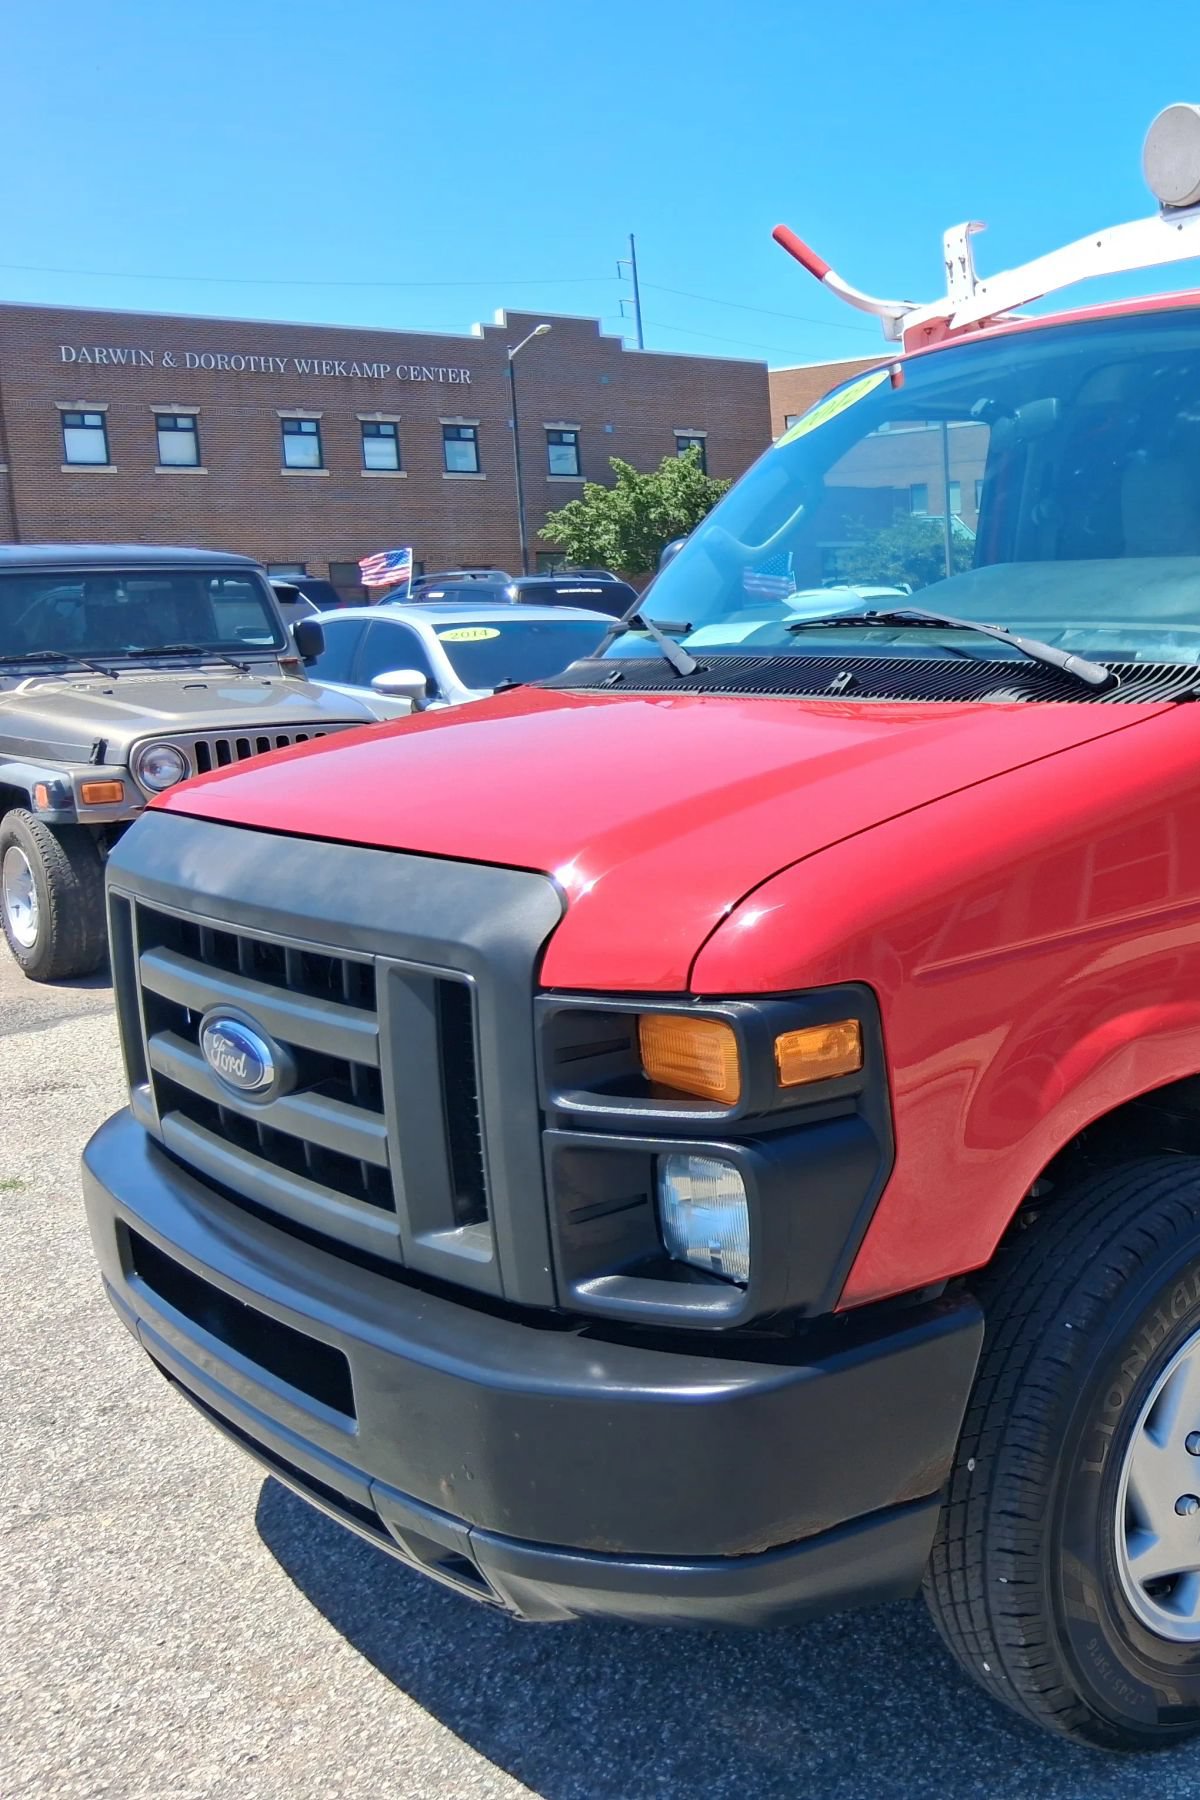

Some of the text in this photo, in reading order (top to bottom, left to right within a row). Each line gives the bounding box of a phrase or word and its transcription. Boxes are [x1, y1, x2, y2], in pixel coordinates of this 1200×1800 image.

[59, 346, 472, 384] DARWIN & DOROTHY WIEKAMP CENTER
[450, 629, 488, 640] 2014
[211, 1033, 248, 1078] Ford
